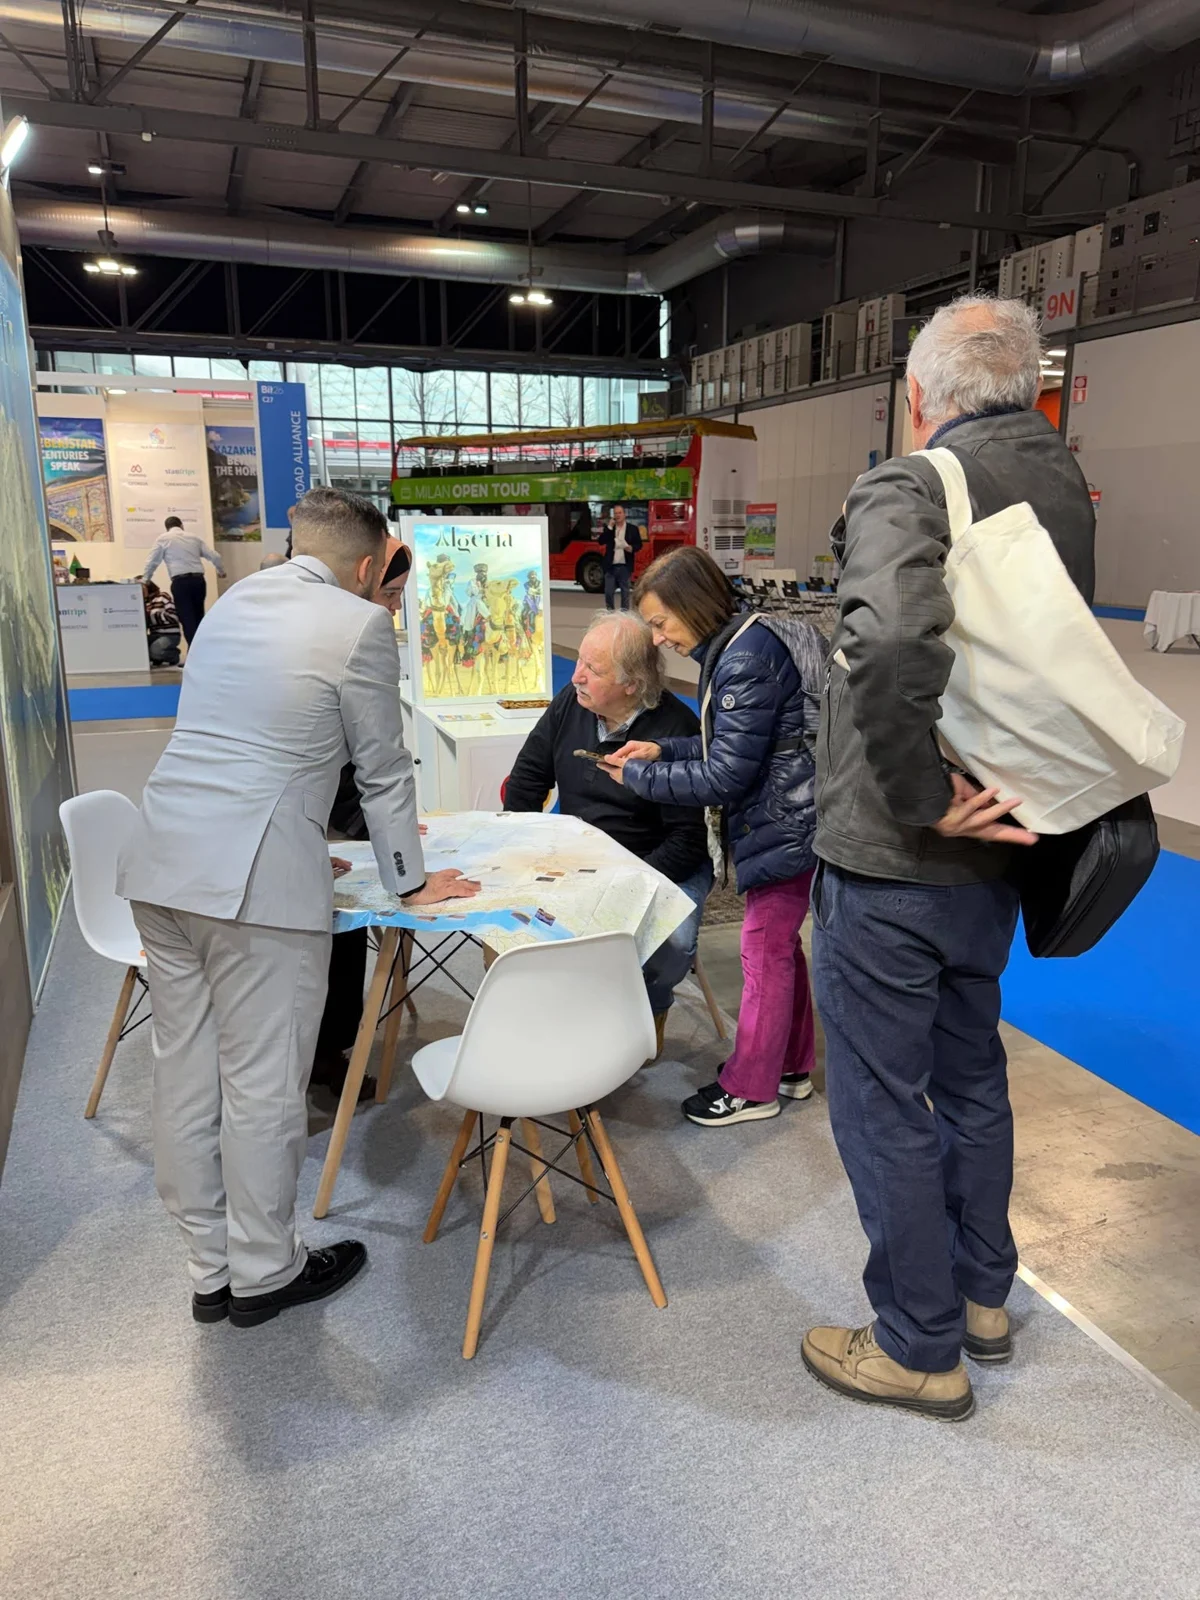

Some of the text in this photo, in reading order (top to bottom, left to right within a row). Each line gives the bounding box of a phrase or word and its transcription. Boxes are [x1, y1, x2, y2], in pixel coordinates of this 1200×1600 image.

[1047, 289, 1075, 321] 9N
[290, 410, 306, 499] ROAD ALLIANCE
[50, 461, 81, 471] SPEAK
[214, 466, 234, 477] THE
[415, 482, 530, 499] MILAN OPEN TOUR
[435, 526, 513, 554] Algeria
